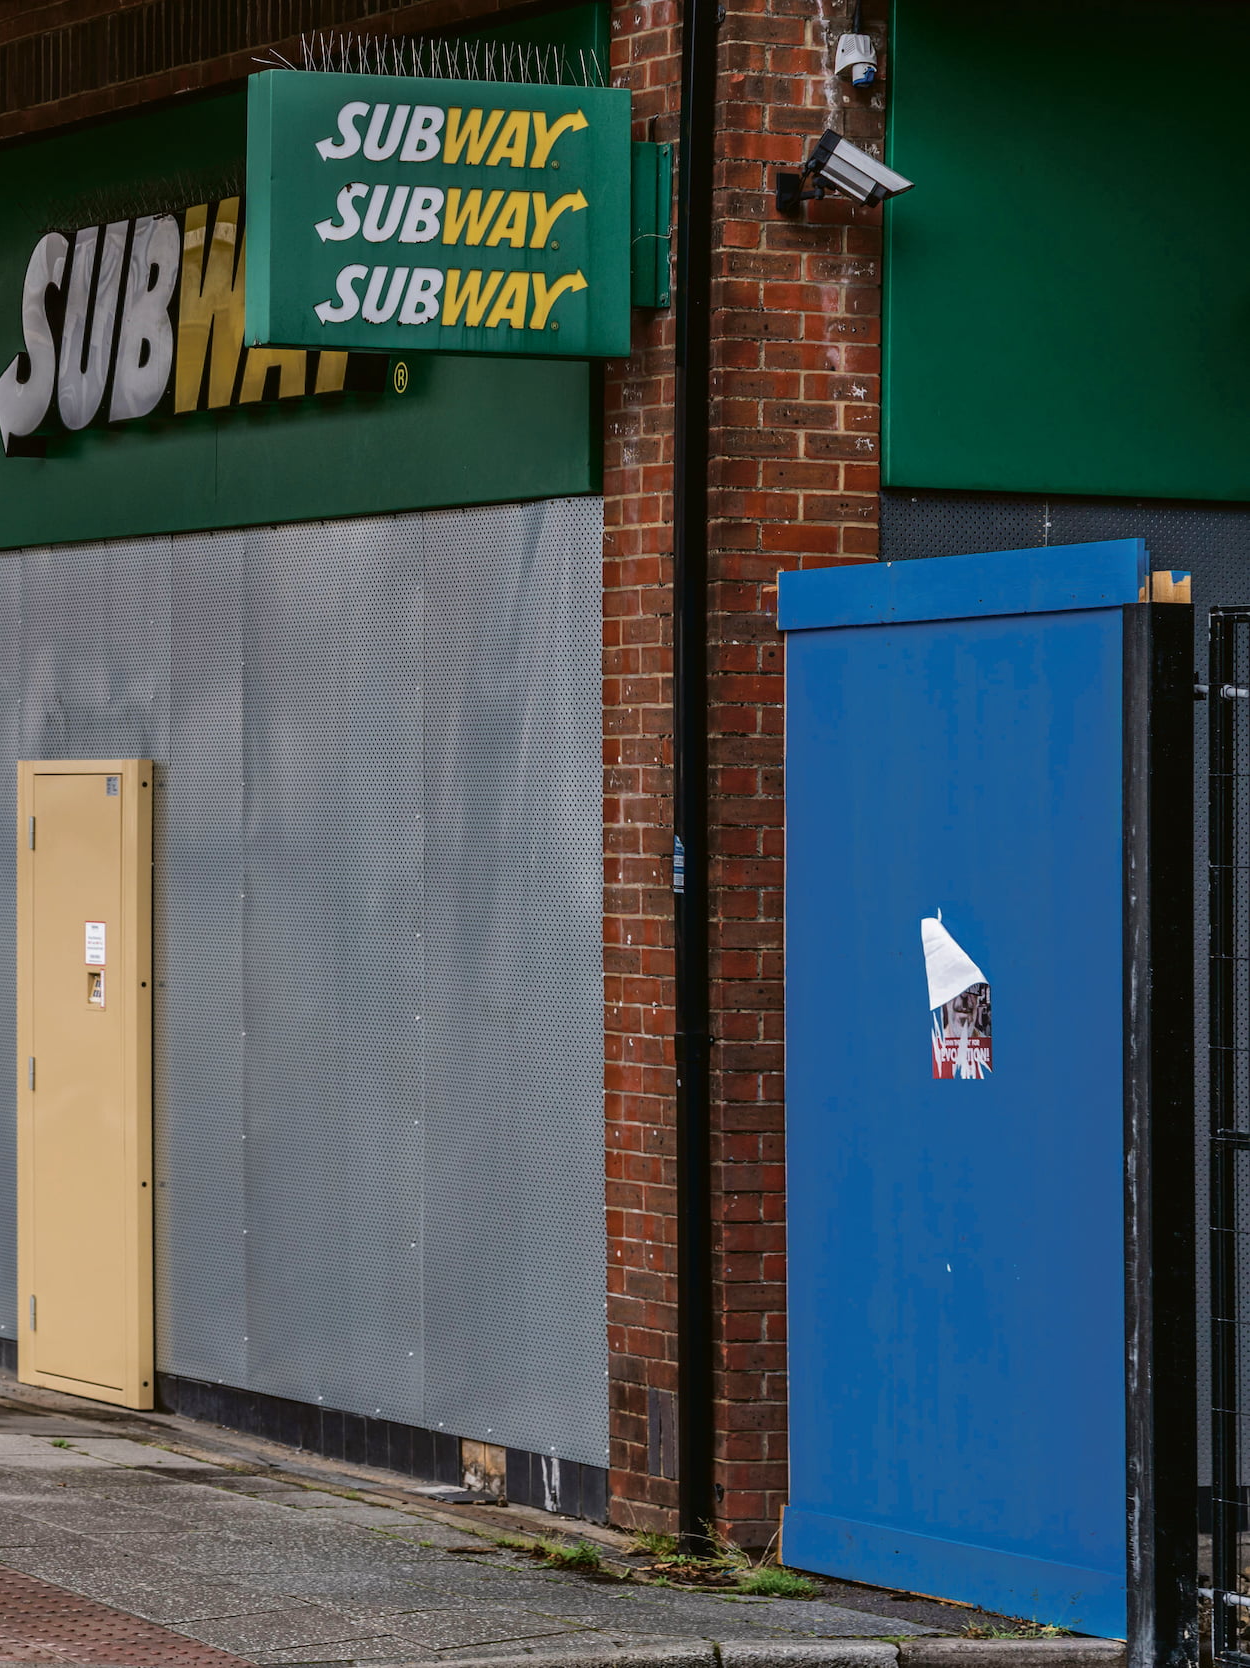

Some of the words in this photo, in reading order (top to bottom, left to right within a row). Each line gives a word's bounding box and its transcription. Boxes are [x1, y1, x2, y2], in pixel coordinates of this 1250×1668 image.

[315, 101, 589, 168] SUBWAY
[315, 182, 589, 248] SUBWAY
[313, 264, 588, 330] SUBWAY
